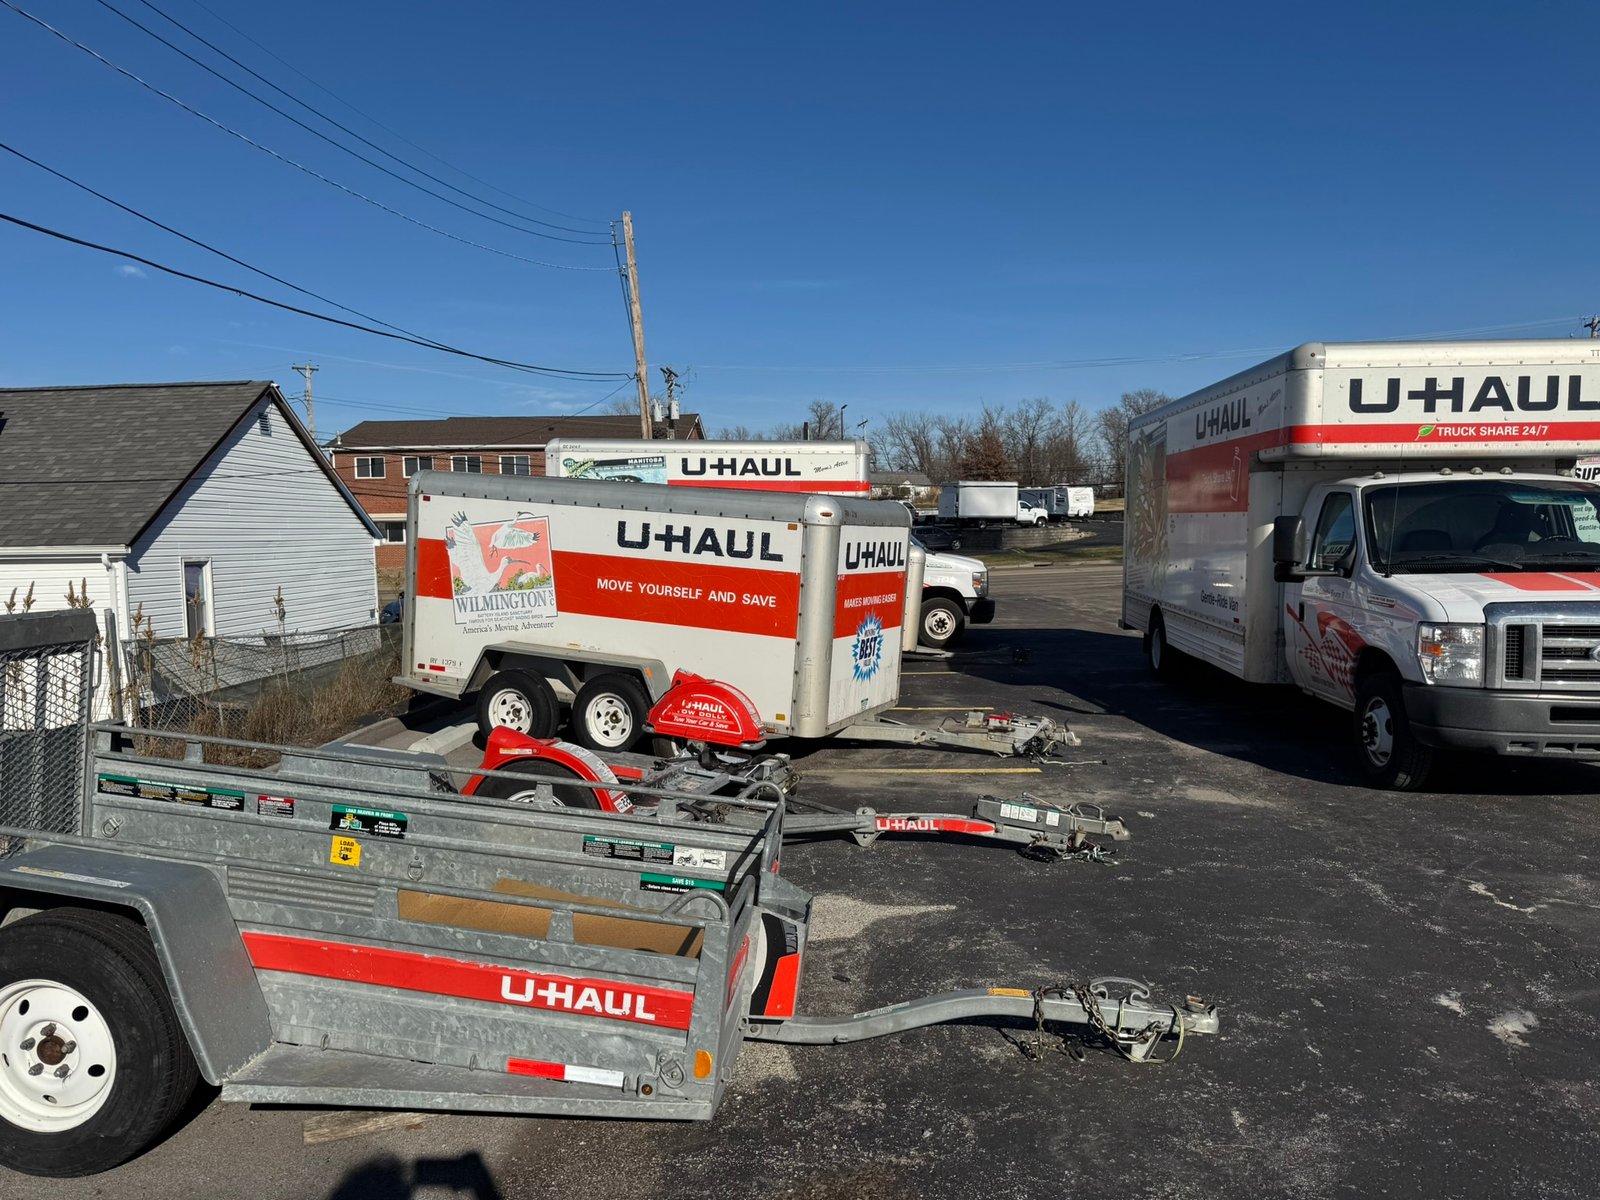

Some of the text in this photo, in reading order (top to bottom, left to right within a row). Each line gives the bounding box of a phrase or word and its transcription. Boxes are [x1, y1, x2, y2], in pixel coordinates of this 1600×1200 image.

[1349, 375, 1600, 413] U-HAUL
[1196, 397, 1251, 440] U-HAUL
[1437, 425, 1549, 437] TRUCK SHARE 24/7
[628, 456, 663, 465] MANITOBA
[681, 457, 801, 476] U-HAUL
[617, 520, 784, 562] U-HAUL
[845, 542, 904, 570] U-HAUL
[455, 589, 547, 614] WILMINGTON
[596, 578, 777, 608] MOVE YOURSELF AND SAVE
[844, 594, 896, 609] MAKES MOVING EASIER
[1228, 596, 1239, 612] Van
[463, 621, 554, 634] America's Moving Adventure
[859, 636, 877, 660] BEST
[673, 715, 685, 723] Tow
[698, 711, 728, 720] DOLLY
[876, 818, 939, 831] U-HAUL
[501, 975, 656, 1021] U-HAUL
